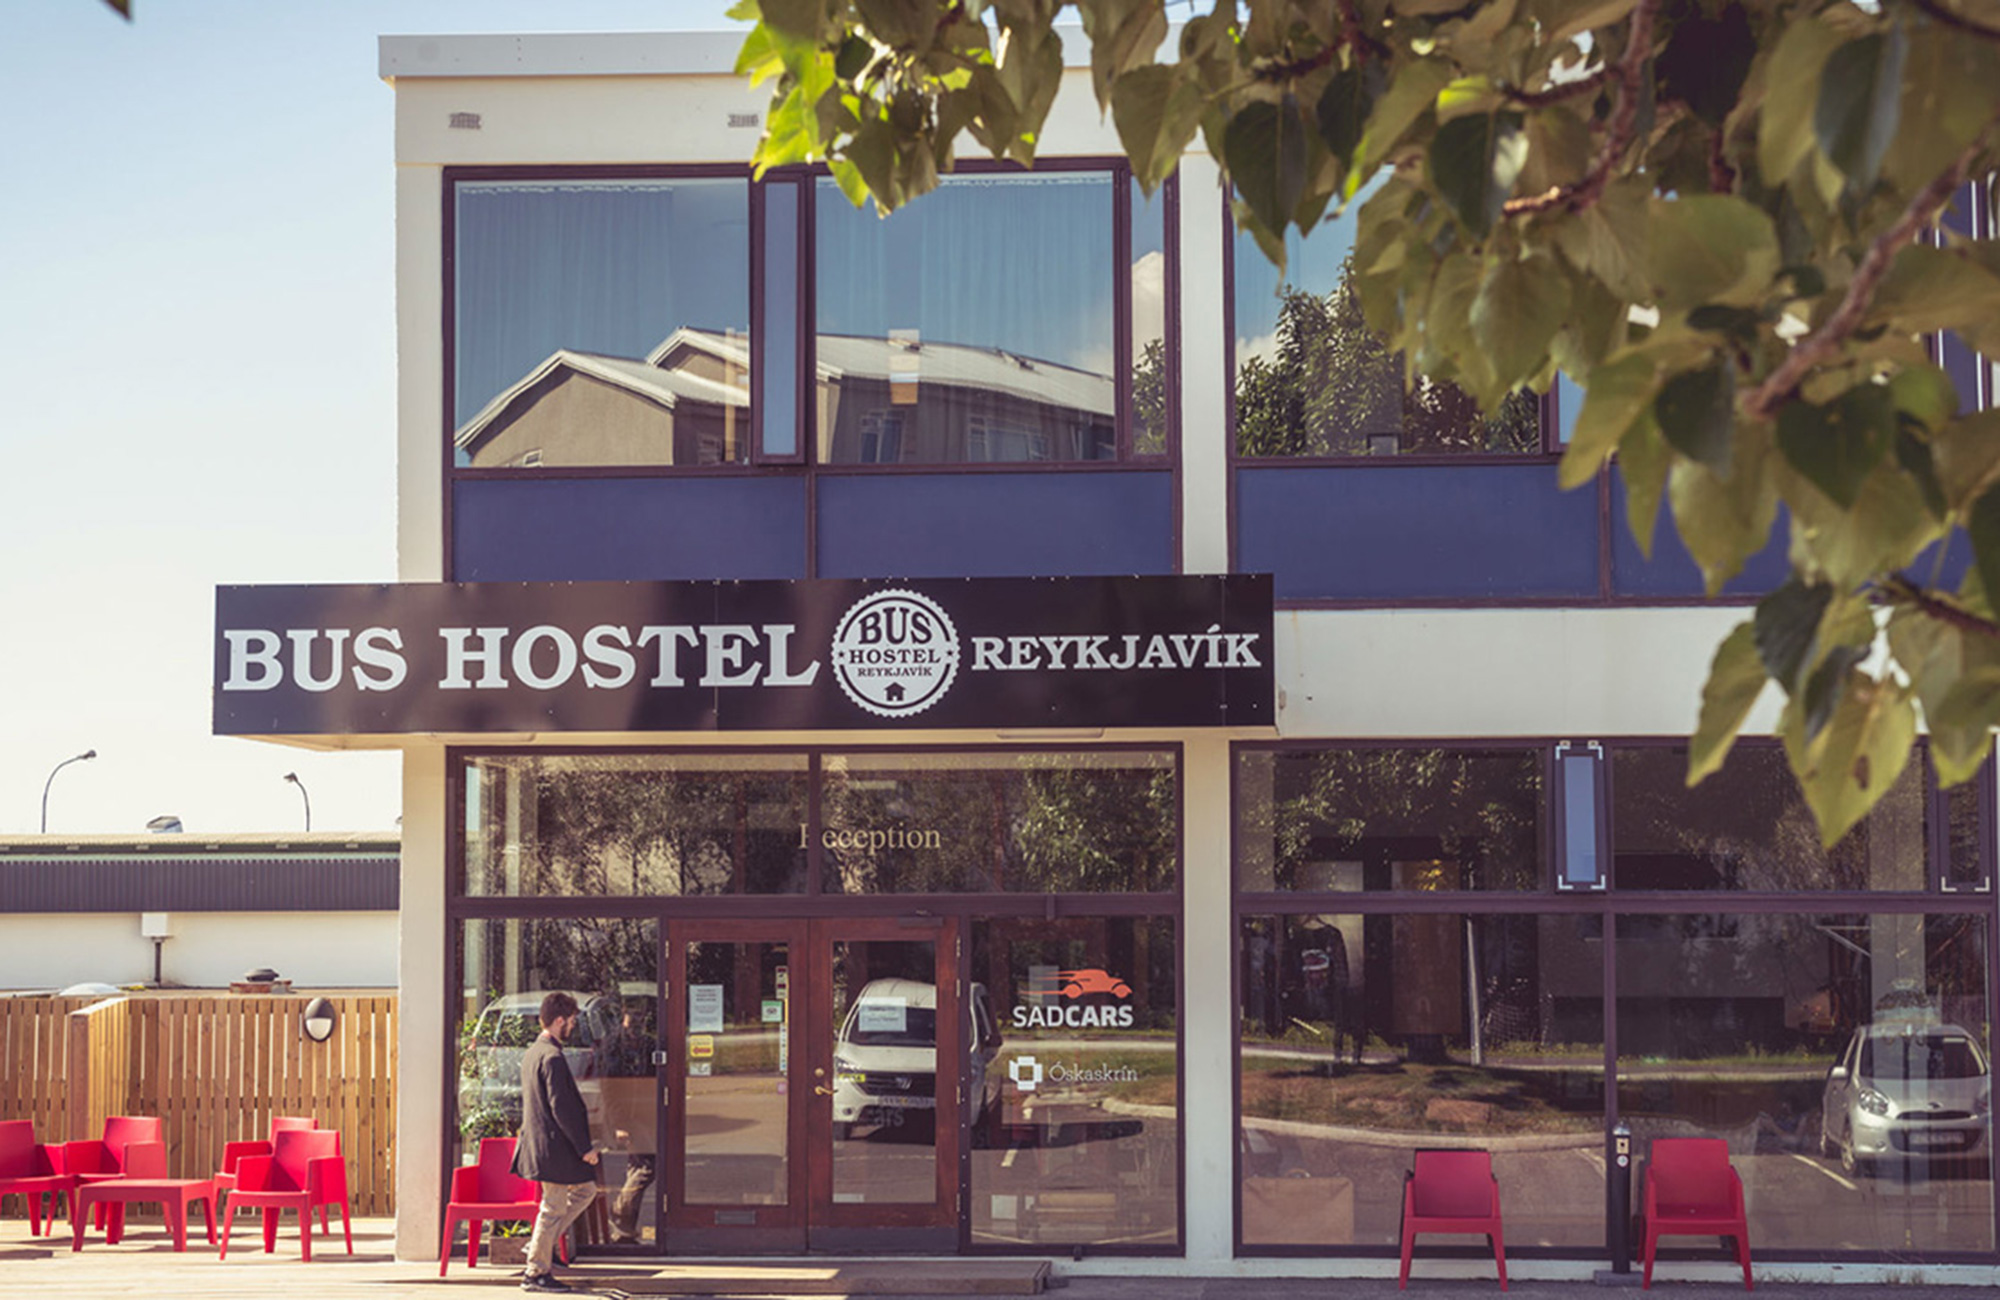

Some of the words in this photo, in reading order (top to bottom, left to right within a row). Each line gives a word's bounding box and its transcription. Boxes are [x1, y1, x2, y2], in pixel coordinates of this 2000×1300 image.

[858, 606, 933, 645] BUS
[222, 627, 408, 692] BUS
[438, 624, 821, 690] HOSTEL
[848, 648, 941, 665] HOSTEL
[971, 624, 1261, 670] REYKJAVÍK
[857, 664, 933, 678] REYKJAVÍK
[1012, 1004, 1134, 1028] SADCARS
[1049, 1061, 1139, 1082] Óskaskrín
